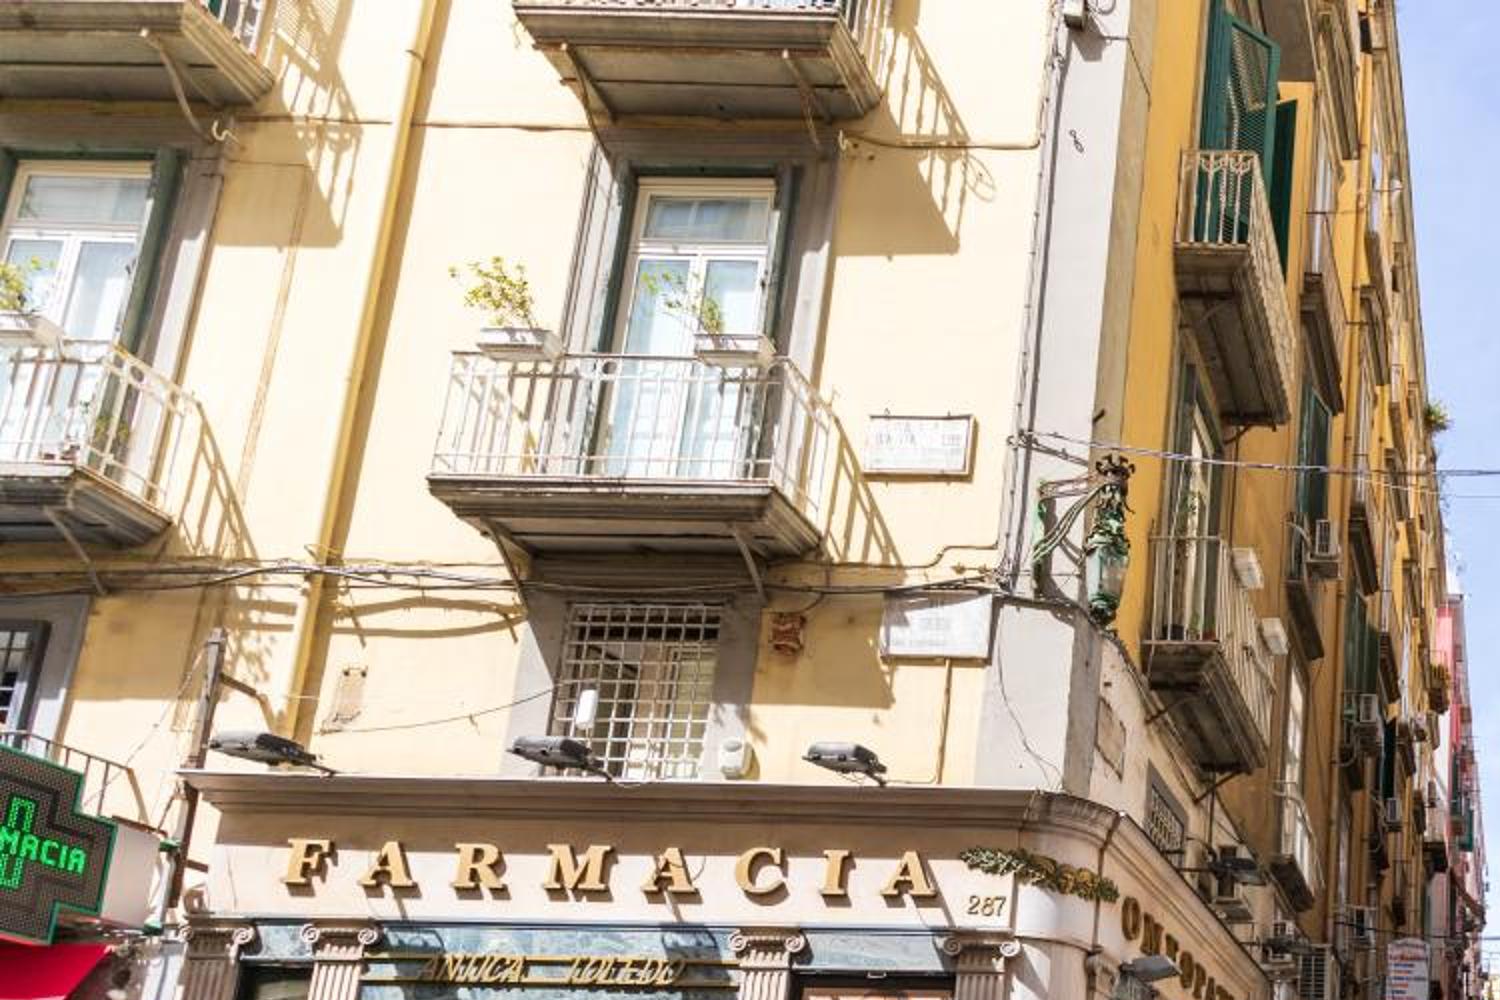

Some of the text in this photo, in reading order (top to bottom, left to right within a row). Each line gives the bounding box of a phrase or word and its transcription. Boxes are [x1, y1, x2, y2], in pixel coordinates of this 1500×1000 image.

[284, 837, 938, 899] FARMACIA
[966, 894, 1006, 917] 287
[418, 953, 686, 985] ANTICA TOLEDO
